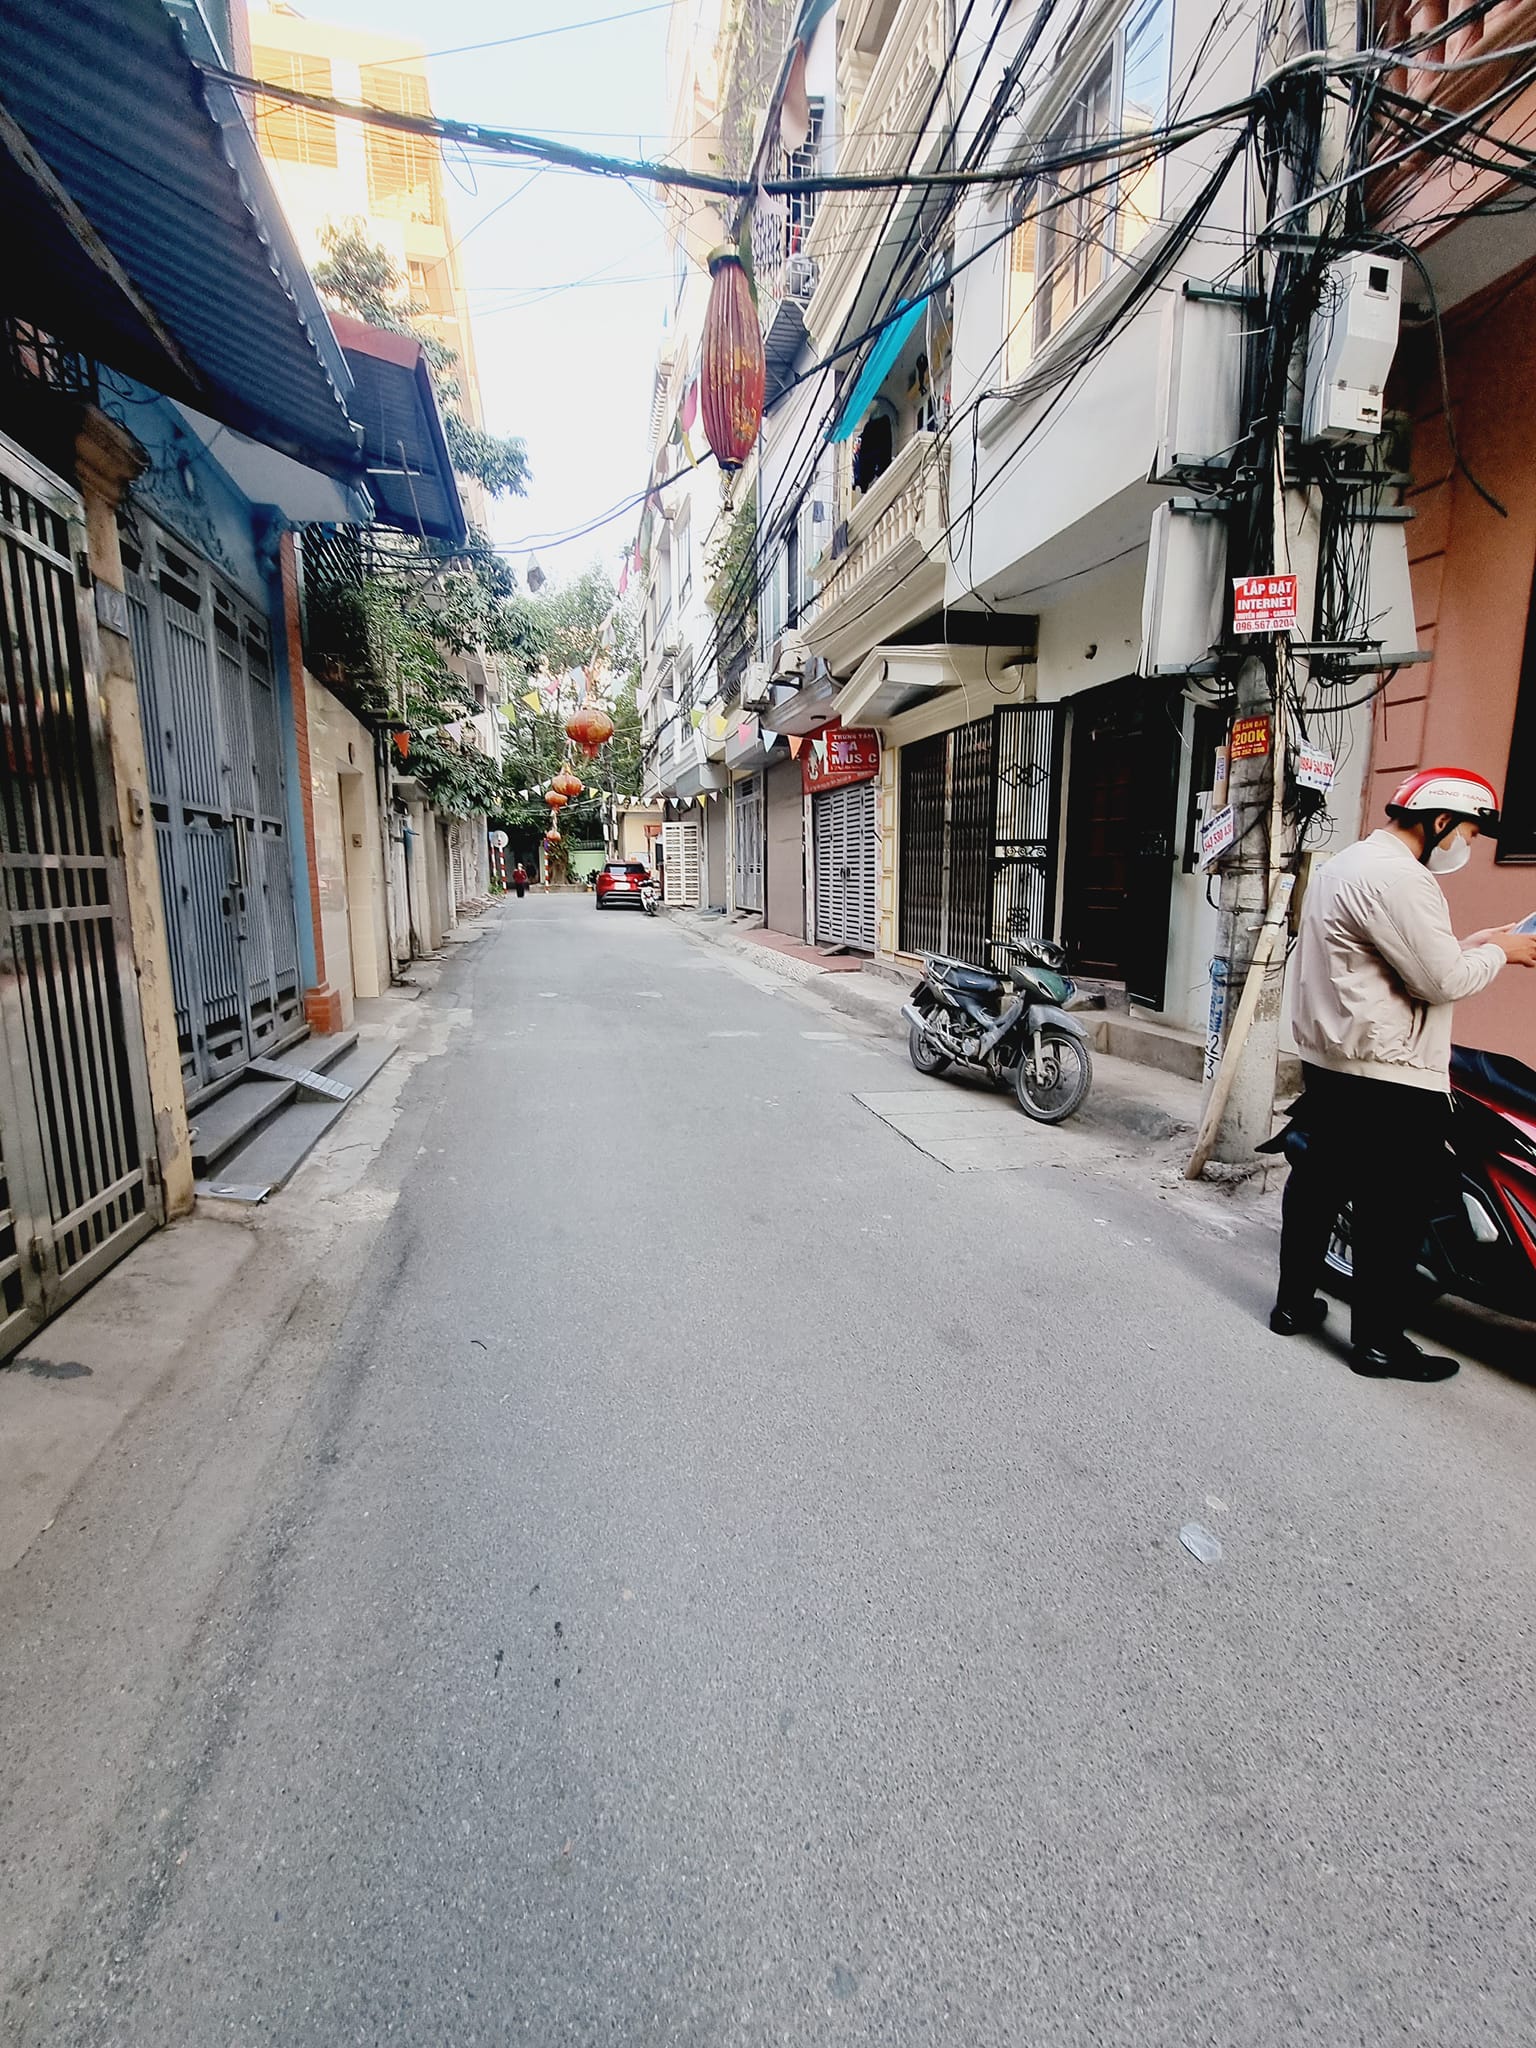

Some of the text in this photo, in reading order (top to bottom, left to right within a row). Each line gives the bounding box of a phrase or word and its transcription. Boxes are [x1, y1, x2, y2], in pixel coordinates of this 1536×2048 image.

[1268, 580, 1292, 596] ĐẶT
[1237, 597, 1293, 610] INTERNET
[1235, 728, 1266, 746] 200K
[831, 741, 857, 752] SA
